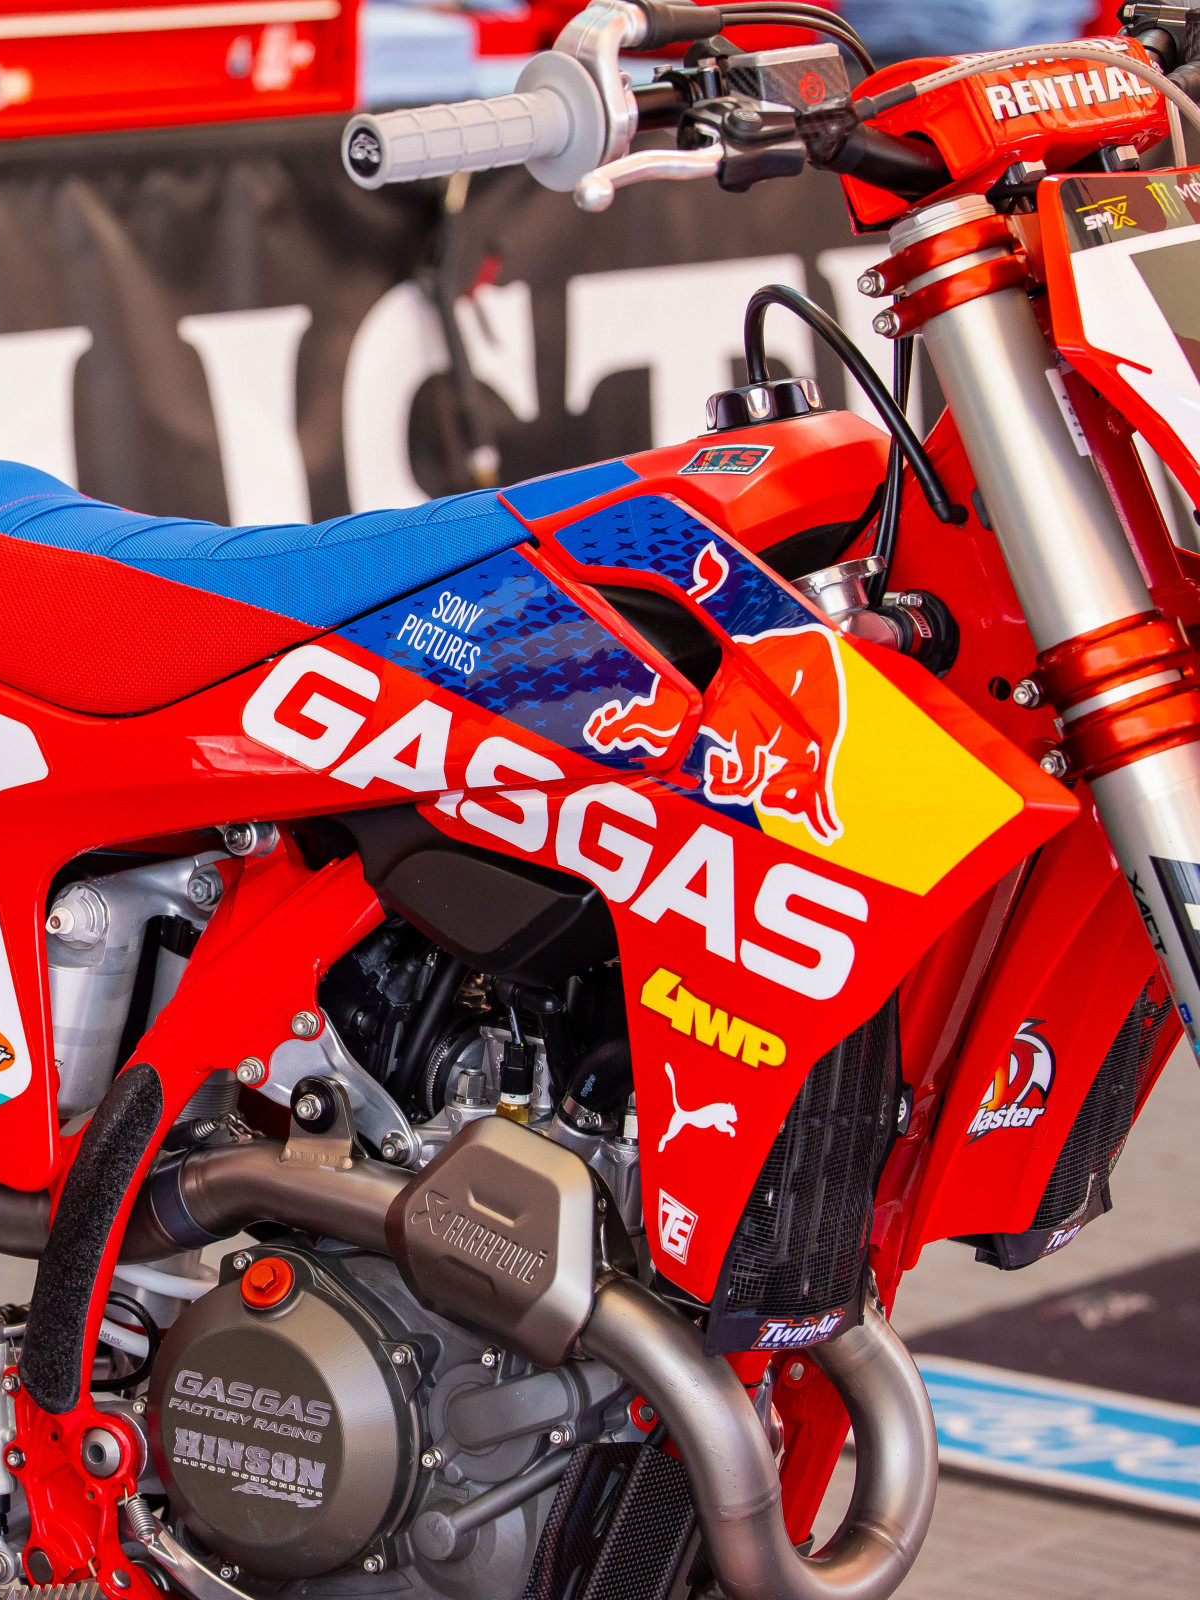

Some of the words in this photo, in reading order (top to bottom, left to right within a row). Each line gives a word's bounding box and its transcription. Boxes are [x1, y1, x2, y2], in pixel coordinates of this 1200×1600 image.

[985, 66, 1153, 121] RENTHAL
[1083, 202, 1137, 230] SMX
[432, 591, 484, 634] SONY
[396, 613, 481, 675] PICTURES
[241, 644, 869, 1001] GASGAS
[640, 967, 787, 1068] 4WP
[580, 1073, 597, 1098] engine
[168, 1397, 251, 1426] FACTORY
[253, 1417, 323, 1444] RACING
[175, 1370, 332, 1427] GASGAS
[173, 1426, 327, 1489] HINSON
[173, 1456, 226, 1475] CLUTCH
[231, 1470, 323, 1498] COMPONENTS
